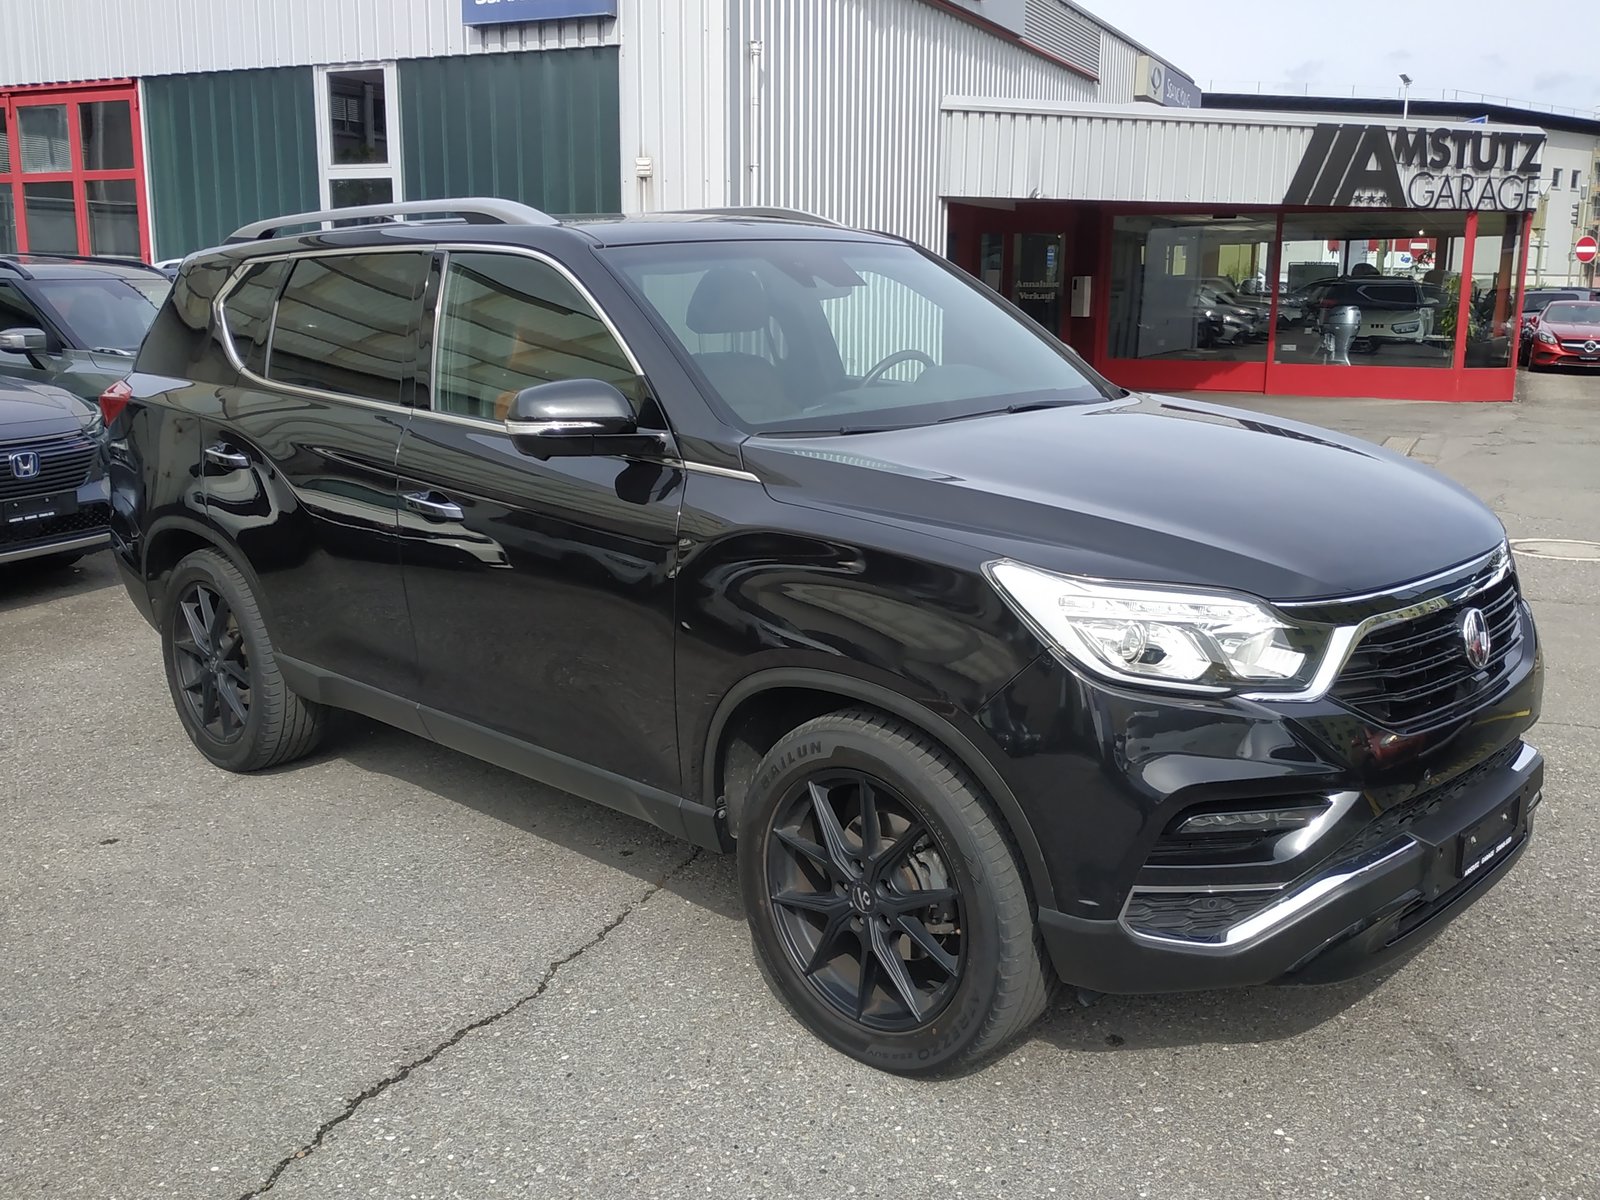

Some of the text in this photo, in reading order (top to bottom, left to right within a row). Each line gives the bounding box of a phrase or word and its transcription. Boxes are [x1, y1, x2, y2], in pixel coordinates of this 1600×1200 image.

[1332, 123, 1547, 208] AMSTUTZ
[1408, 171, 1540, 212] GARAGE
[1015, 279, 1060, 288] Annahme
[1019, 292, 1056, 300] Verkauf
